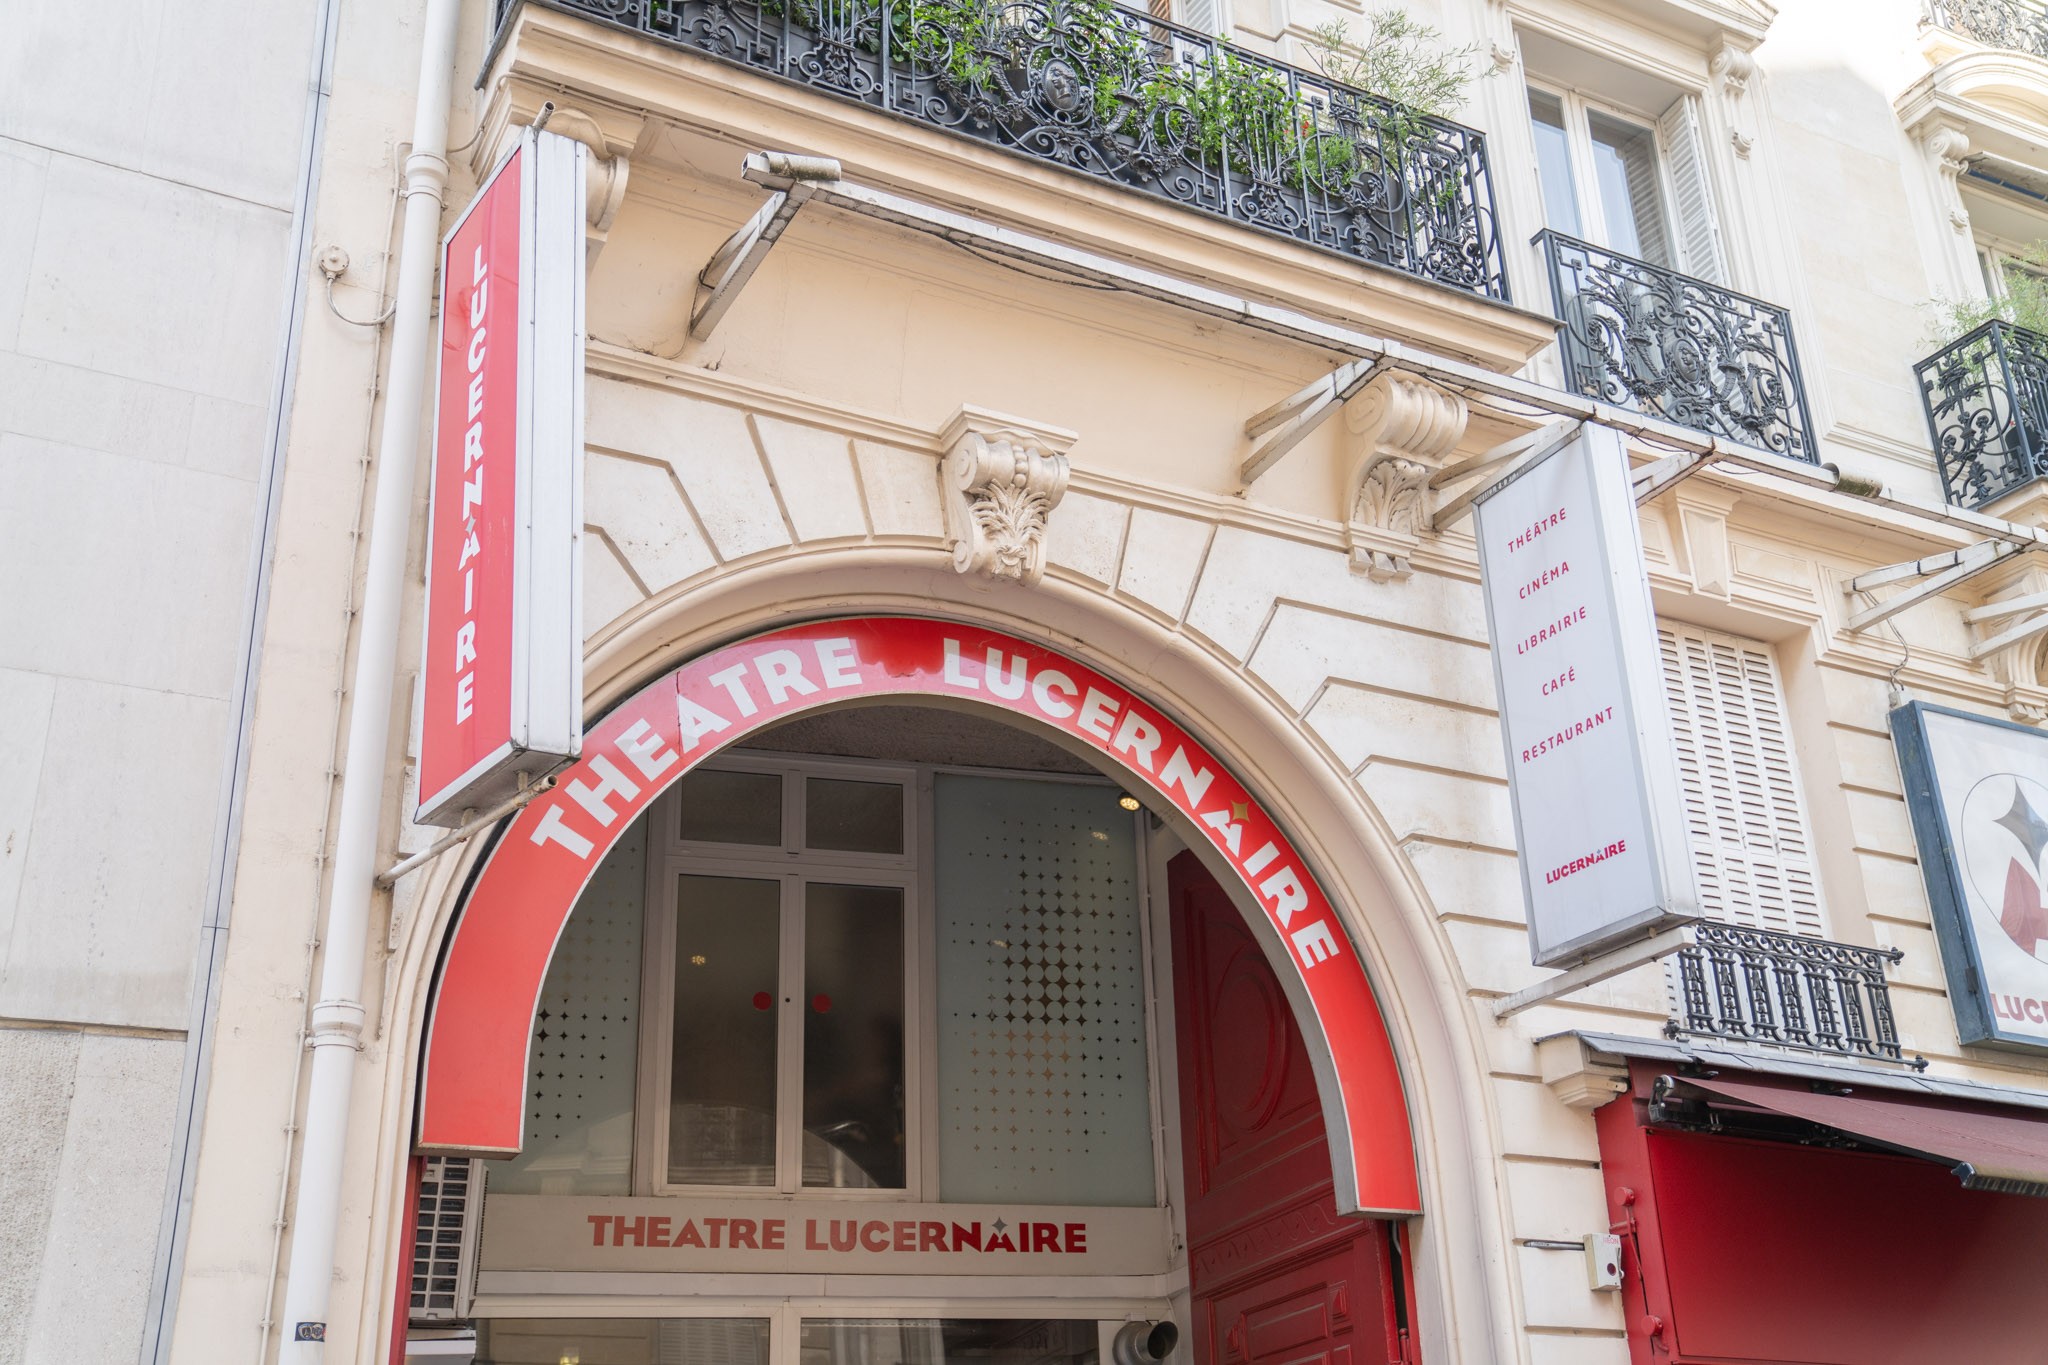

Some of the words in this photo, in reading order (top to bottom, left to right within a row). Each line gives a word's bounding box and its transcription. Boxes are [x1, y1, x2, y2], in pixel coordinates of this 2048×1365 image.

[456, 244, 488, 726] LUCERNAIRE
[1507, 508, 1568, 553] THÉÂTRE
[1519, 561, 1570, 600] CINÉMA
[1517, 606, 1587, 655] LIBRAIRIE
[1541, 666, 1577, 697] CAFÉ
[1523, 706, 1614, 764] RESTAURANT
[530, 637, 862, 862] THEATRE
[943, 637, 1340, 970] LUCERNAIRE
[1546, 840, 1627, 885] LUCERNAIRE
[587, 1215, 785, 1250] THEATRE
[805, 1217, 1088, 1254] LUCERNAIRE
